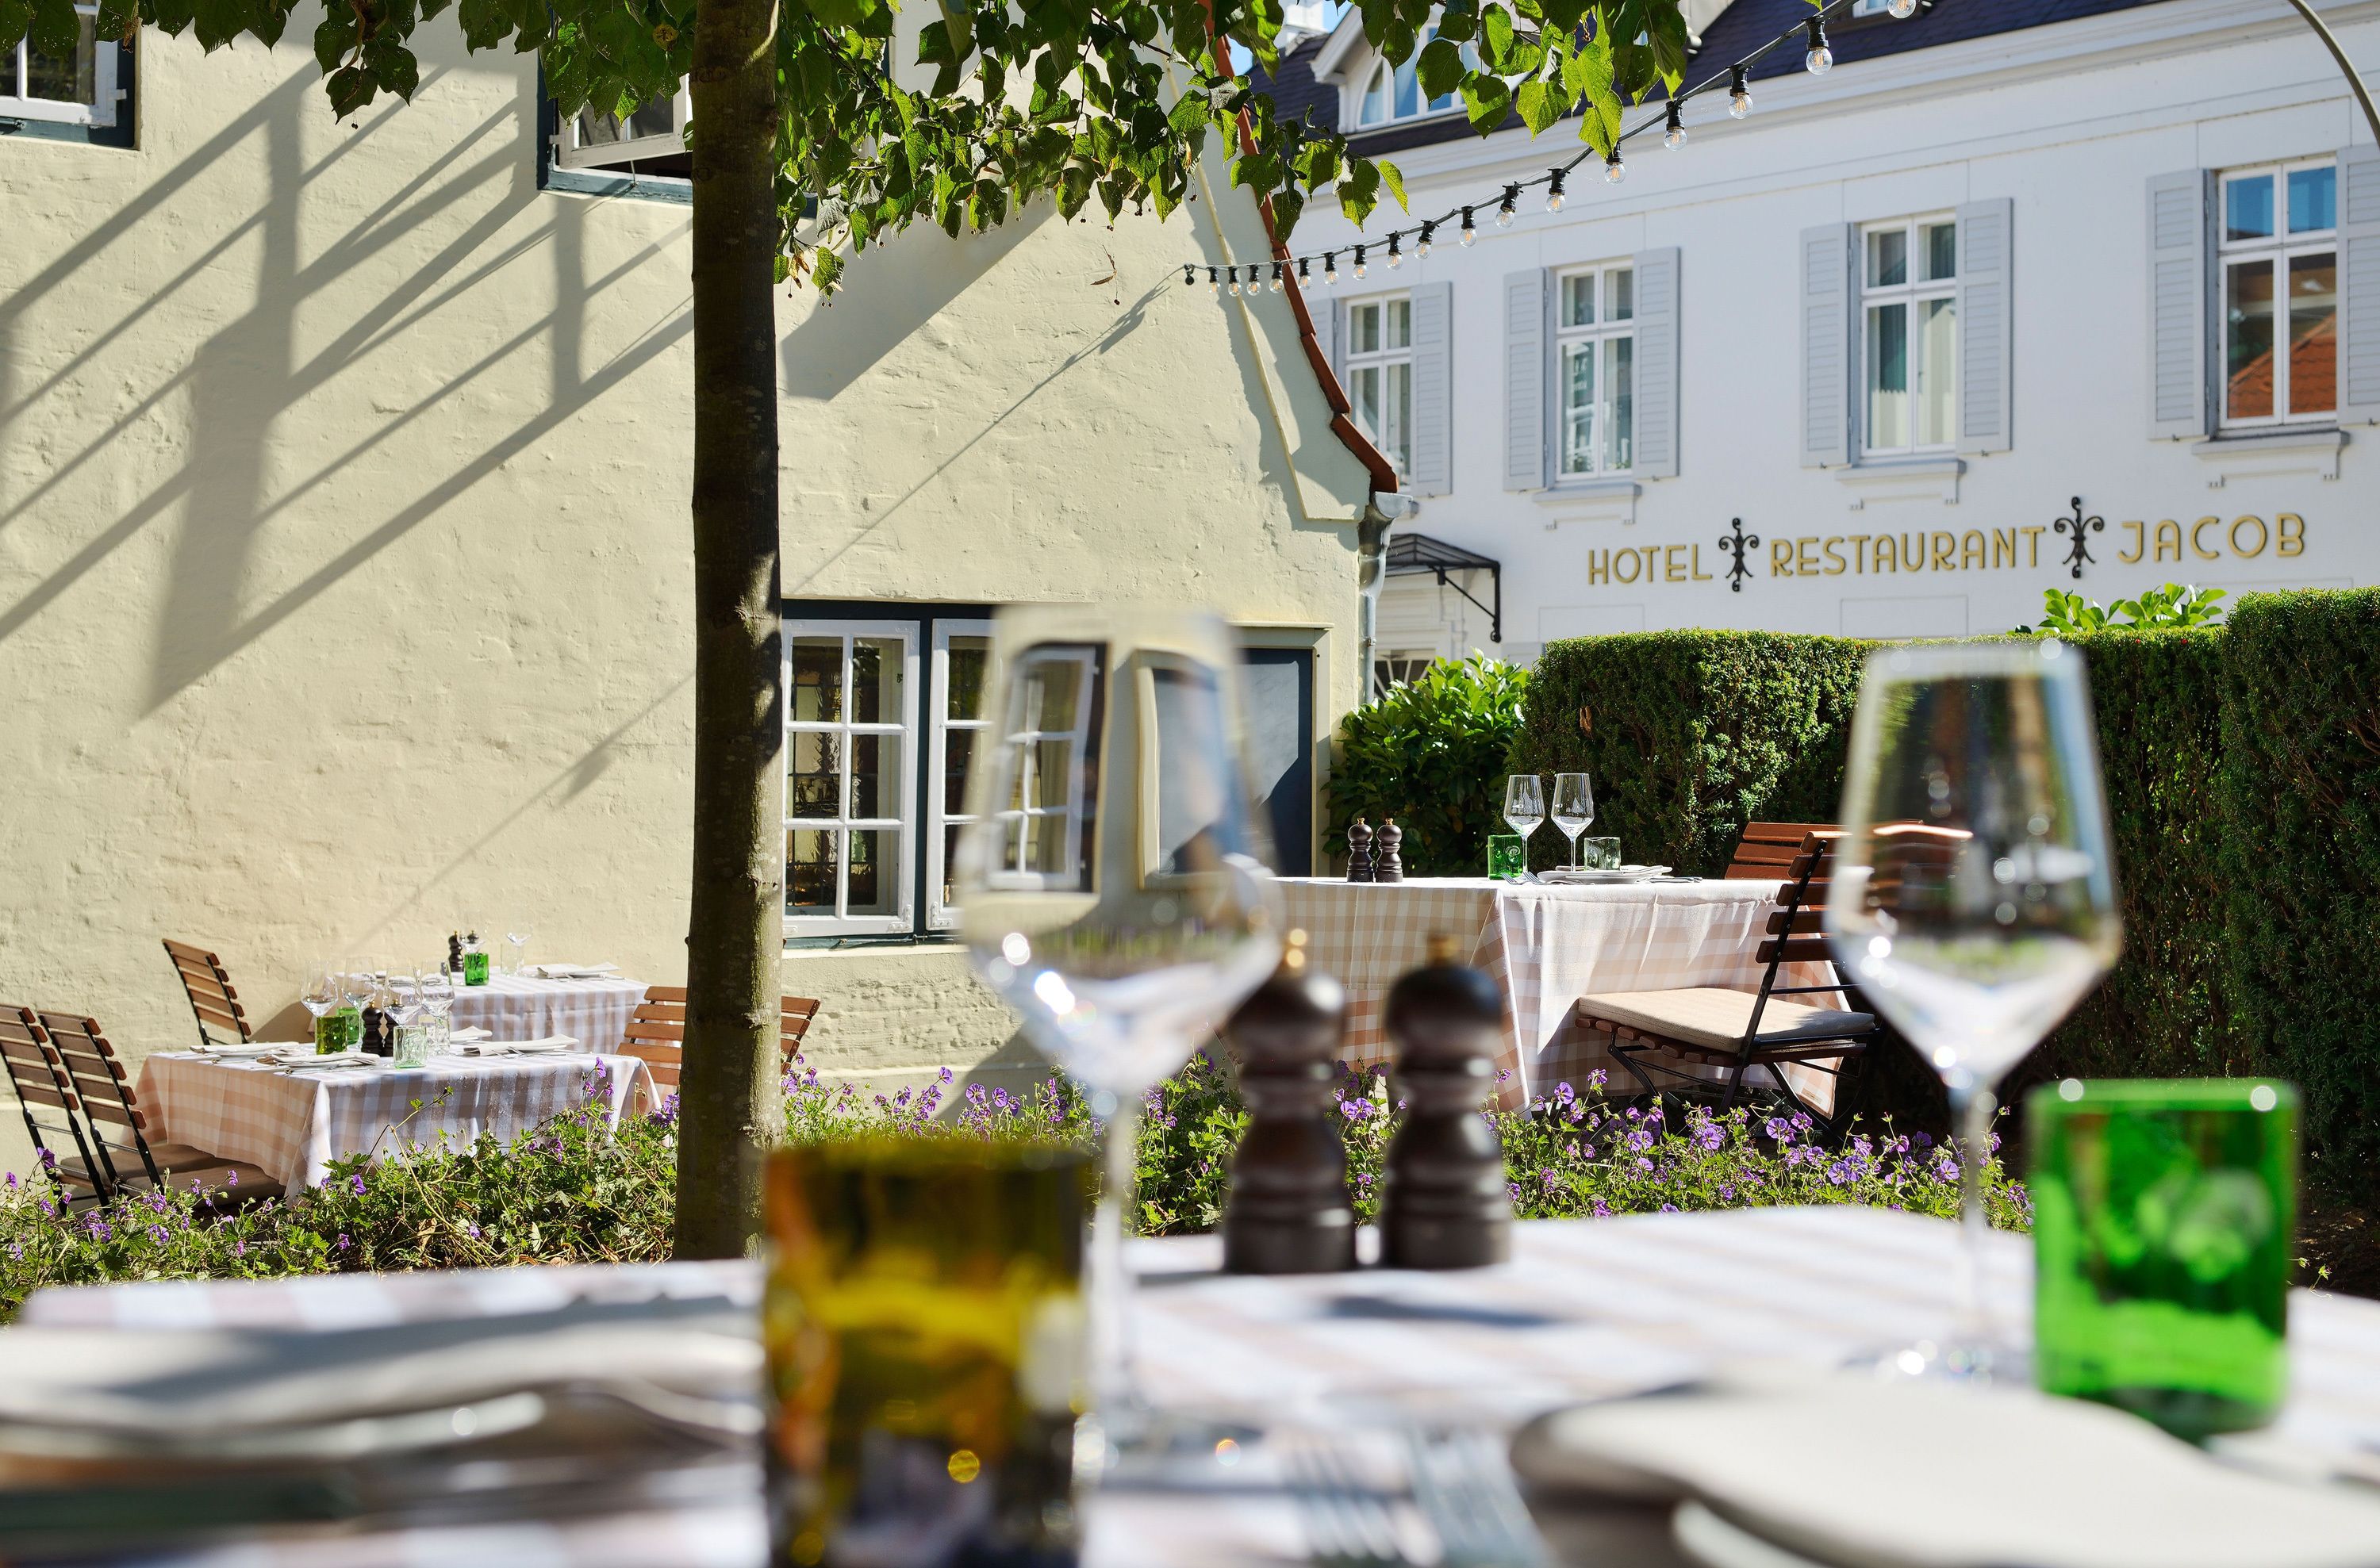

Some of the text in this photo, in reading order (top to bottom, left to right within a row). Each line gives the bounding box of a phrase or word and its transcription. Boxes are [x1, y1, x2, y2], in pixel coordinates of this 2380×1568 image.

[1588, 513, 2305, 585] HOTEL RESTAURANT JACOB
